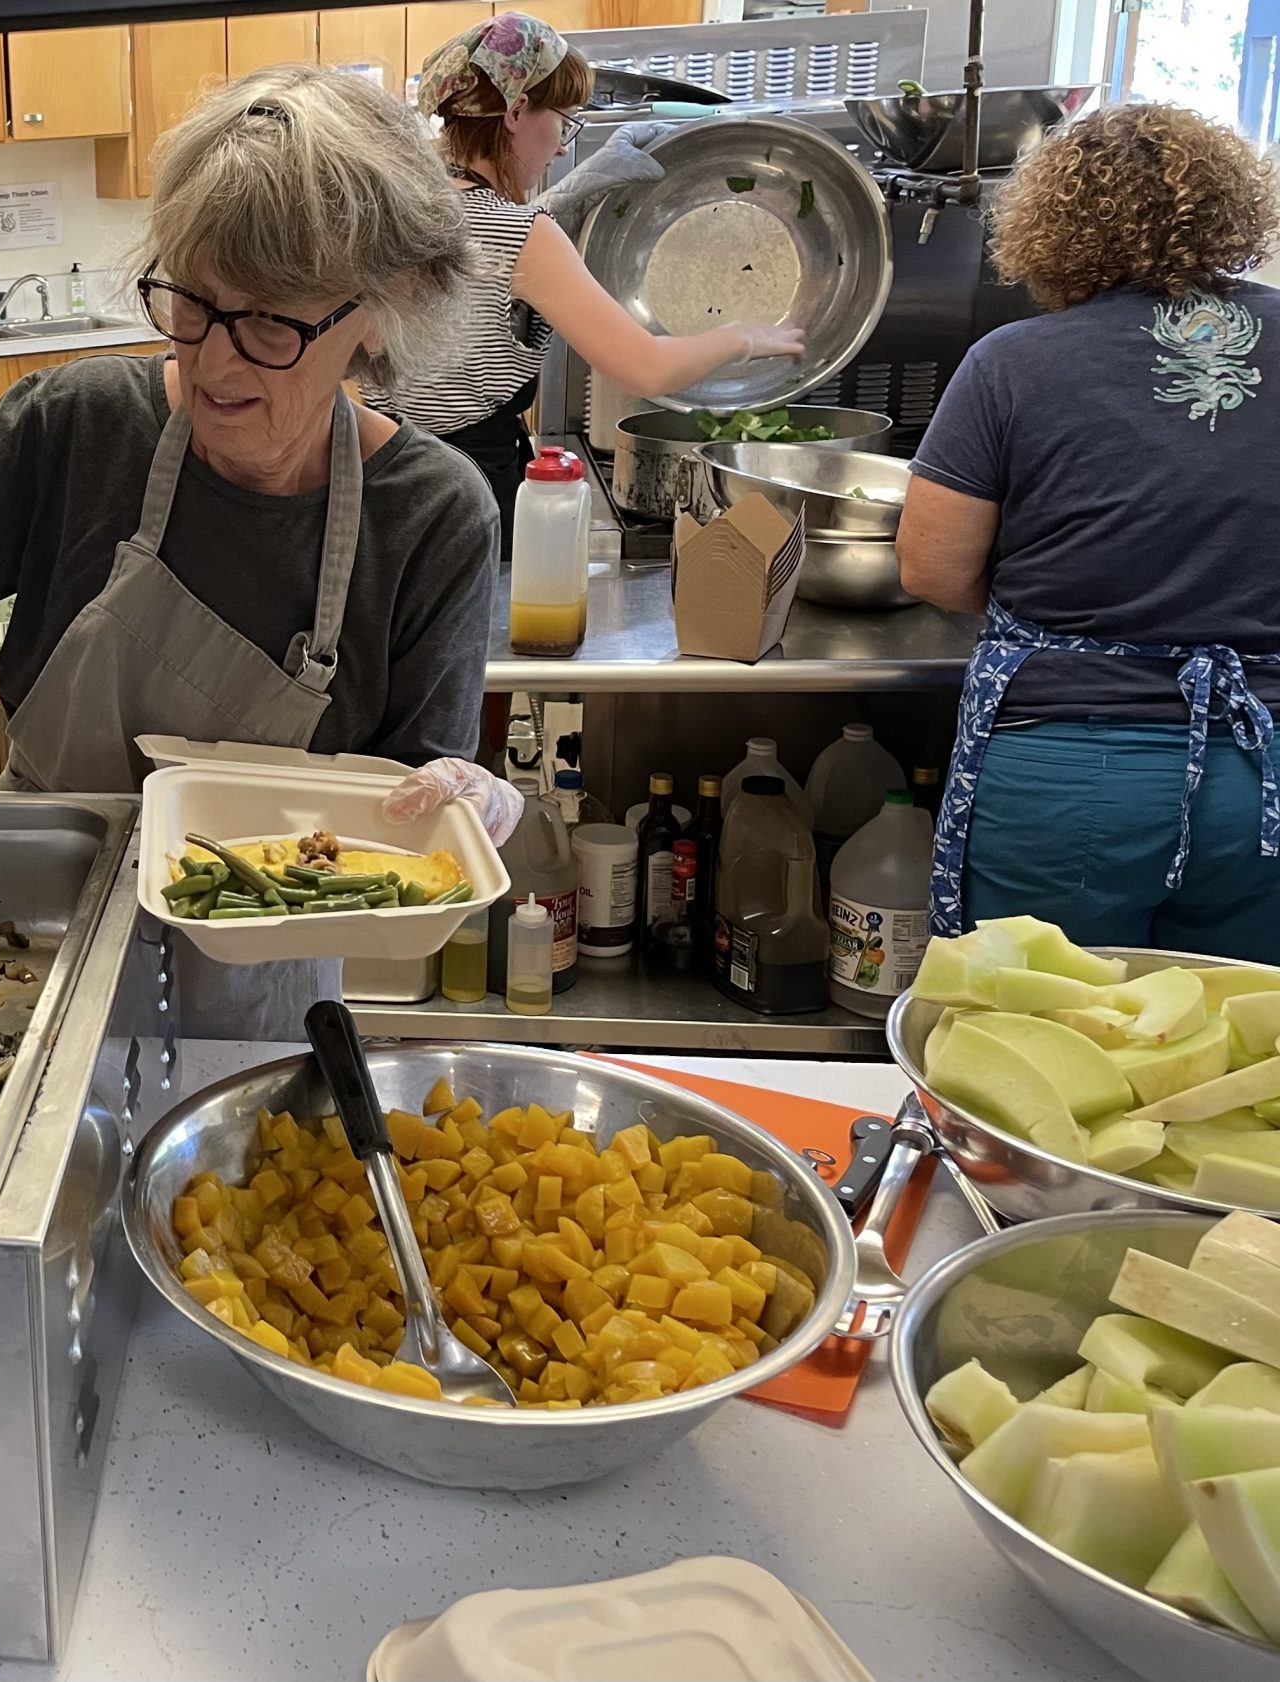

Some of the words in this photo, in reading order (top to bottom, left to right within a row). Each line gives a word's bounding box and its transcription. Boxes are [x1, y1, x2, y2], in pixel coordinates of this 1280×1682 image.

[580, 887, 594, 897] OIL
[552, 896, 573, 909] Four
[832, 903, 858, 926] HEINZ
